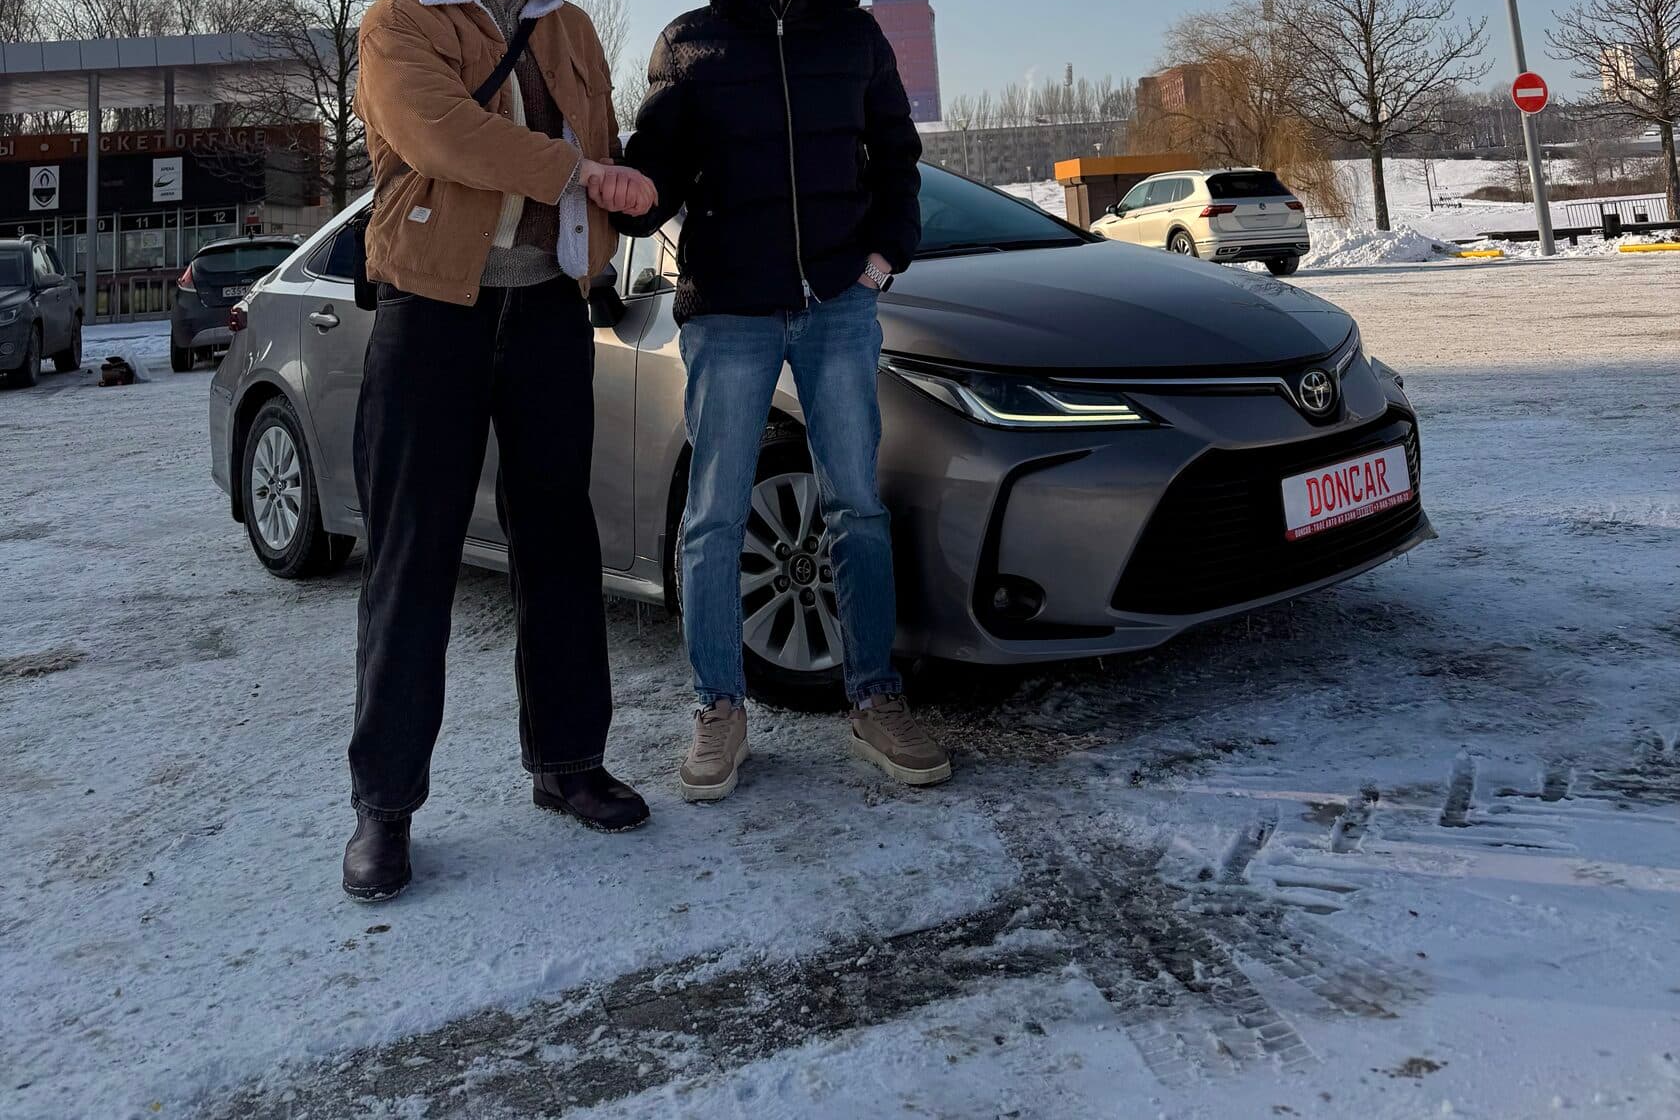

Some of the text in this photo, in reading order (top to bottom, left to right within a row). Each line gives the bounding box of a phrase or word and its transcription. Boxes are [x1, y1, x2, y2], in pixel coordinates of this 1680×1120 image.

[70, 136, 166, 153] TCKET
[213, 211, 226, 222] 12
[136, 217, 149, 228] 11
[17, 225, 25, 236] 9
[1306, 458, 1390, 517] DONCAR
